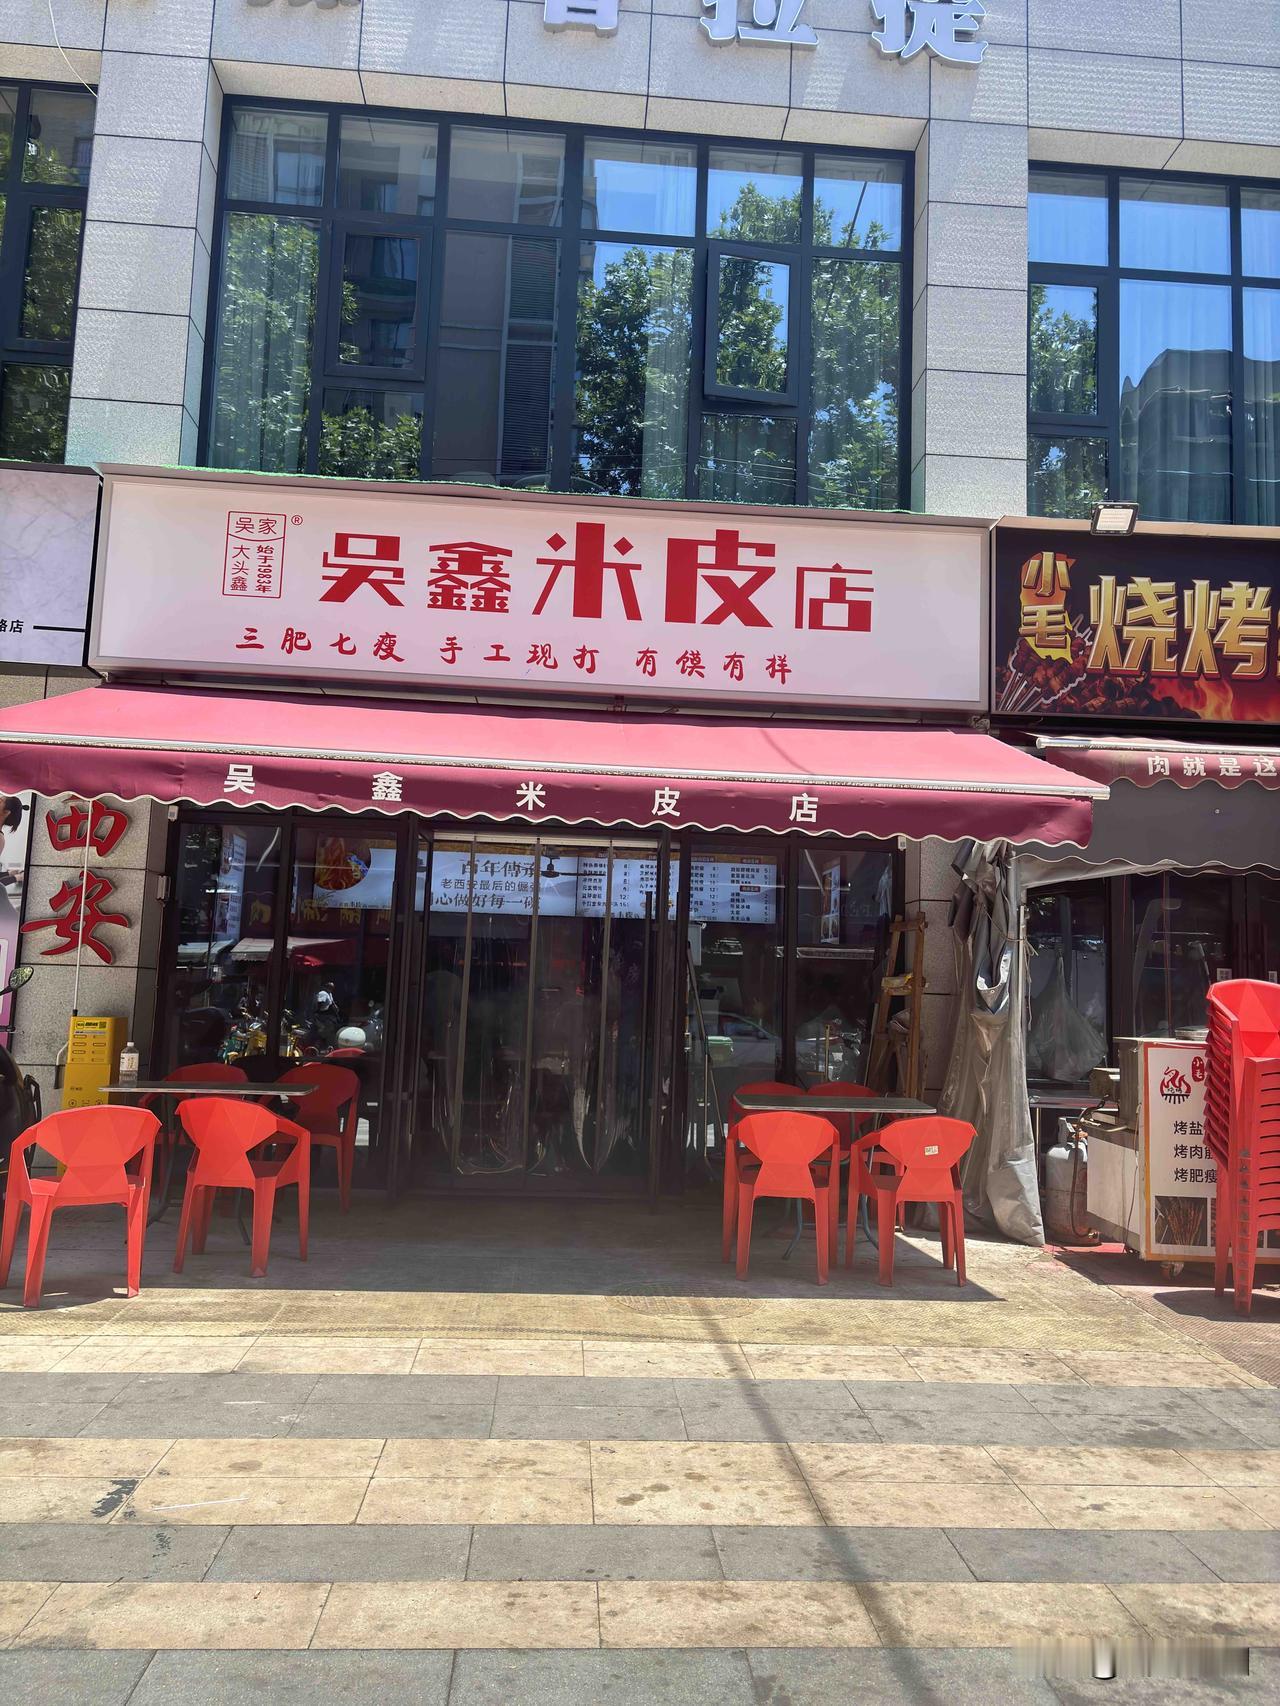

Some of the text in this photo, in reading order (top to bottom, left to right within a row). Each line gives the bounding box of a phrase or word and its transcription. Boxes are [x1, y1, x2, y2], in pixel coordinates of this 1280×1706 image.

[235, 516, 277, 535] 吴家
[230, 544, 251, 592] 大头鑫
[255, 544, 275, 594] 始于1983年
[318, 521, 875, 633] 吴鑫米皮店
[235, 627, 793, 685] 三肥七瘦 手工现打 有馍有样
[1086, 574, 1280, 681] 烧烤
[222, 763, 819, 824] 吴鑫米皮店
[1146, 755, 1278, 777] 肉就是这
[20, 795, 129, 966] 西安
